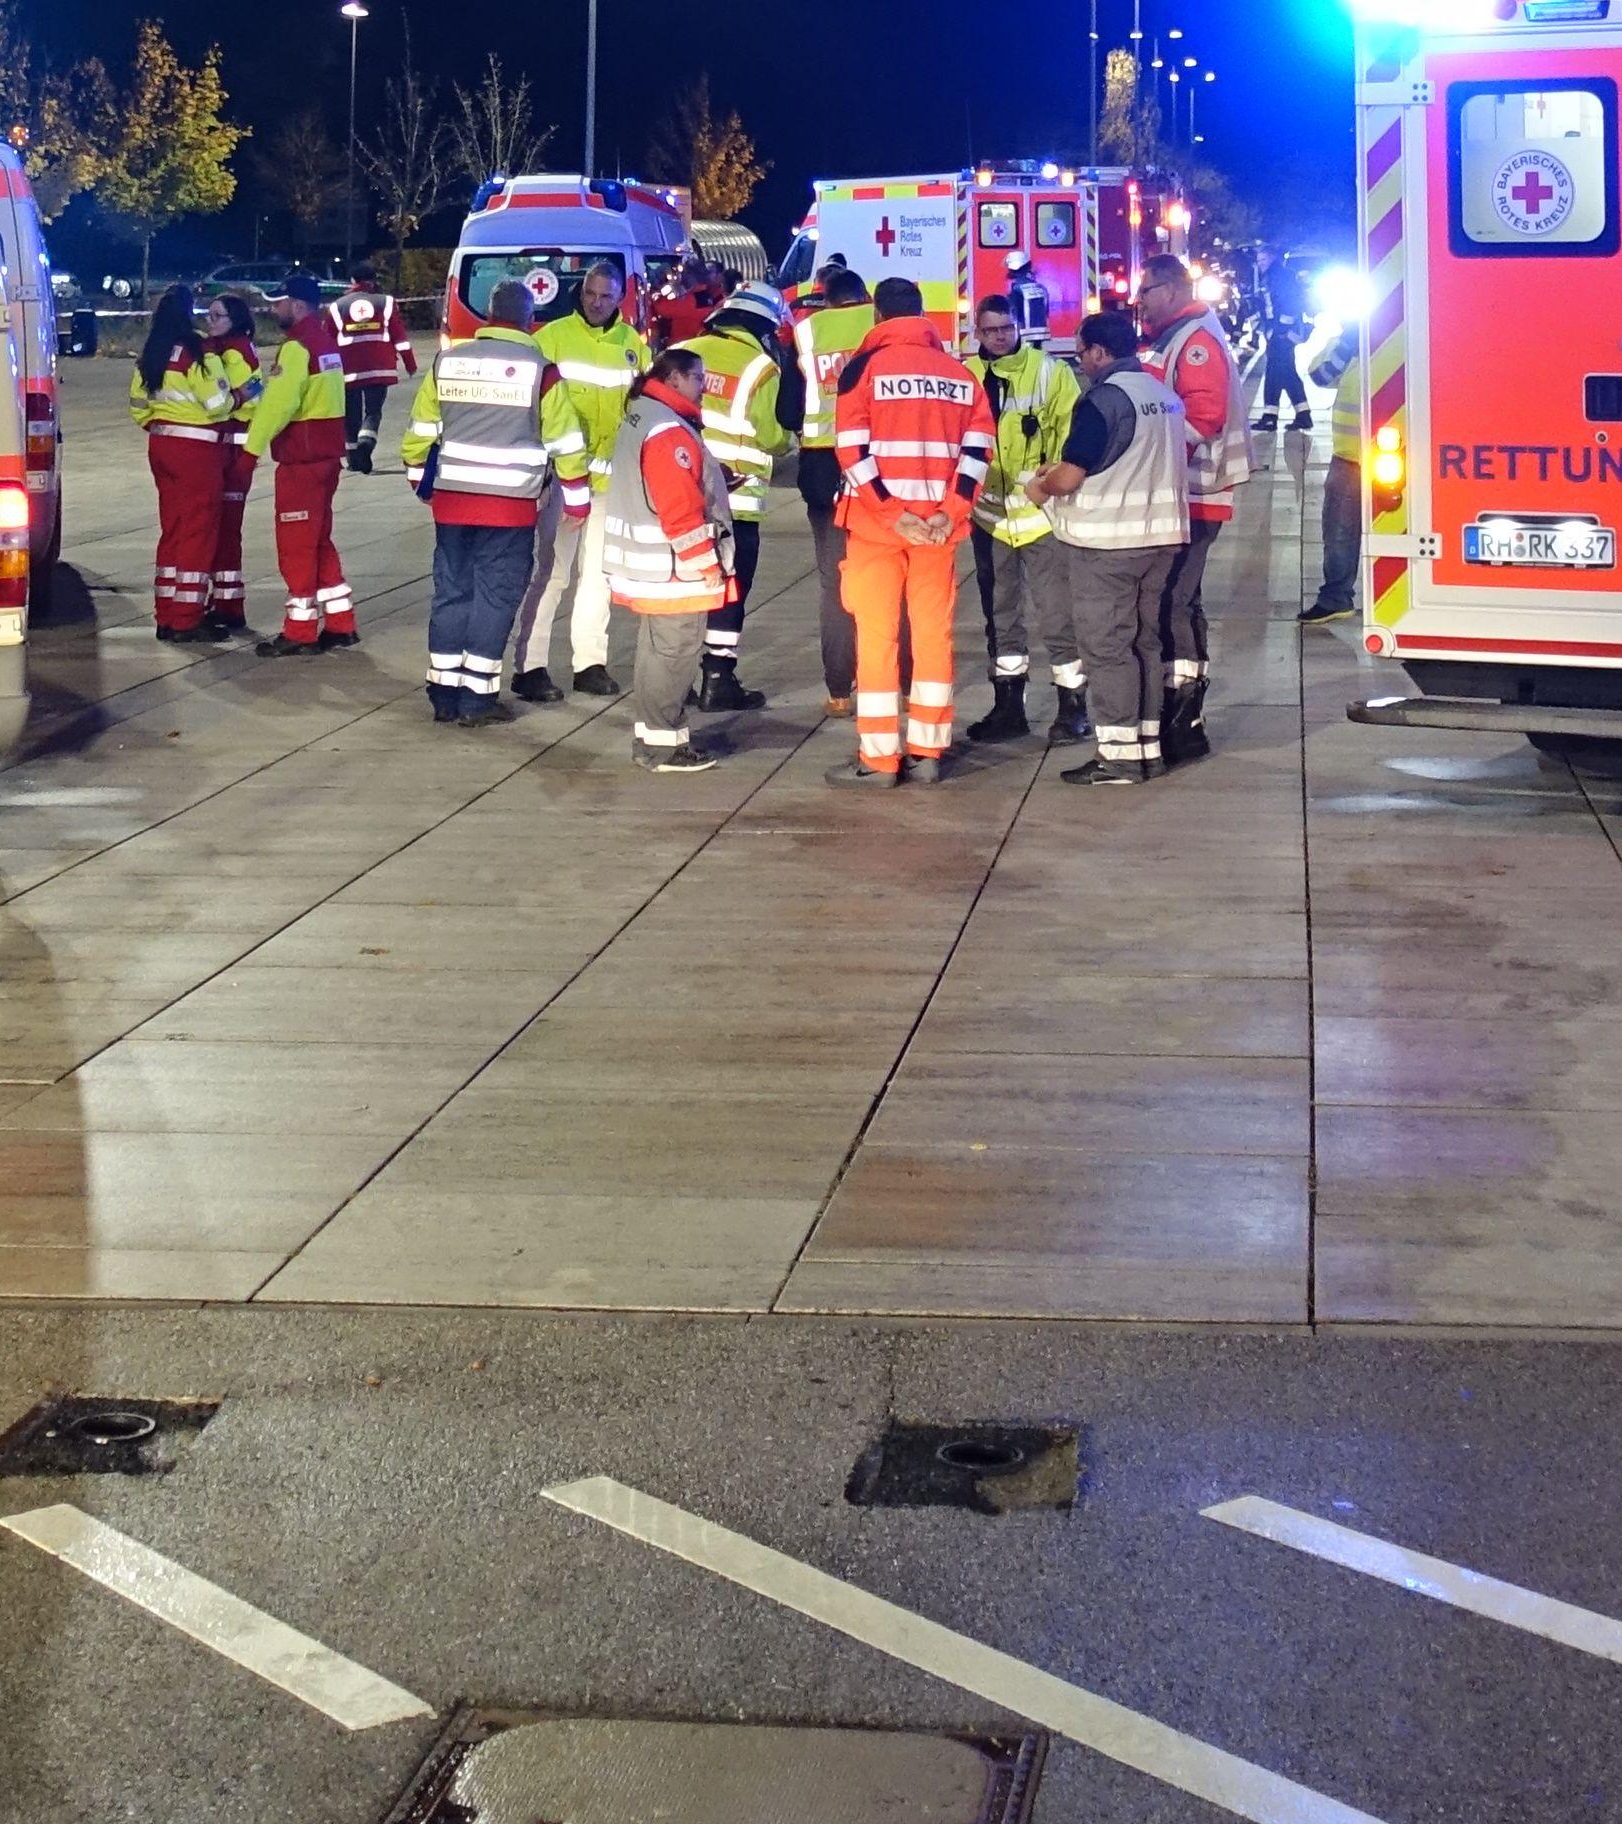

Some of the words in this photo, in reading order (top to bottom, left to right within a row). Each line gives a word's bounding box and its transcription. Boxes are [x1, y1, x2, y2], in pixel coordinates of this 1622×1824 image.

[1497, 155, 1568, 190] BAYERISCHES
[1498, 196, 1530, 231] ROTES
[1534, 195, 1569, 230] KREUZ
[439, 385, 468, 397] Leiter
[880, 378, 970, 401] NOTARZT
[1140, 402, 1158, 416] UG
[1529, 533, 1559, 558] RK
